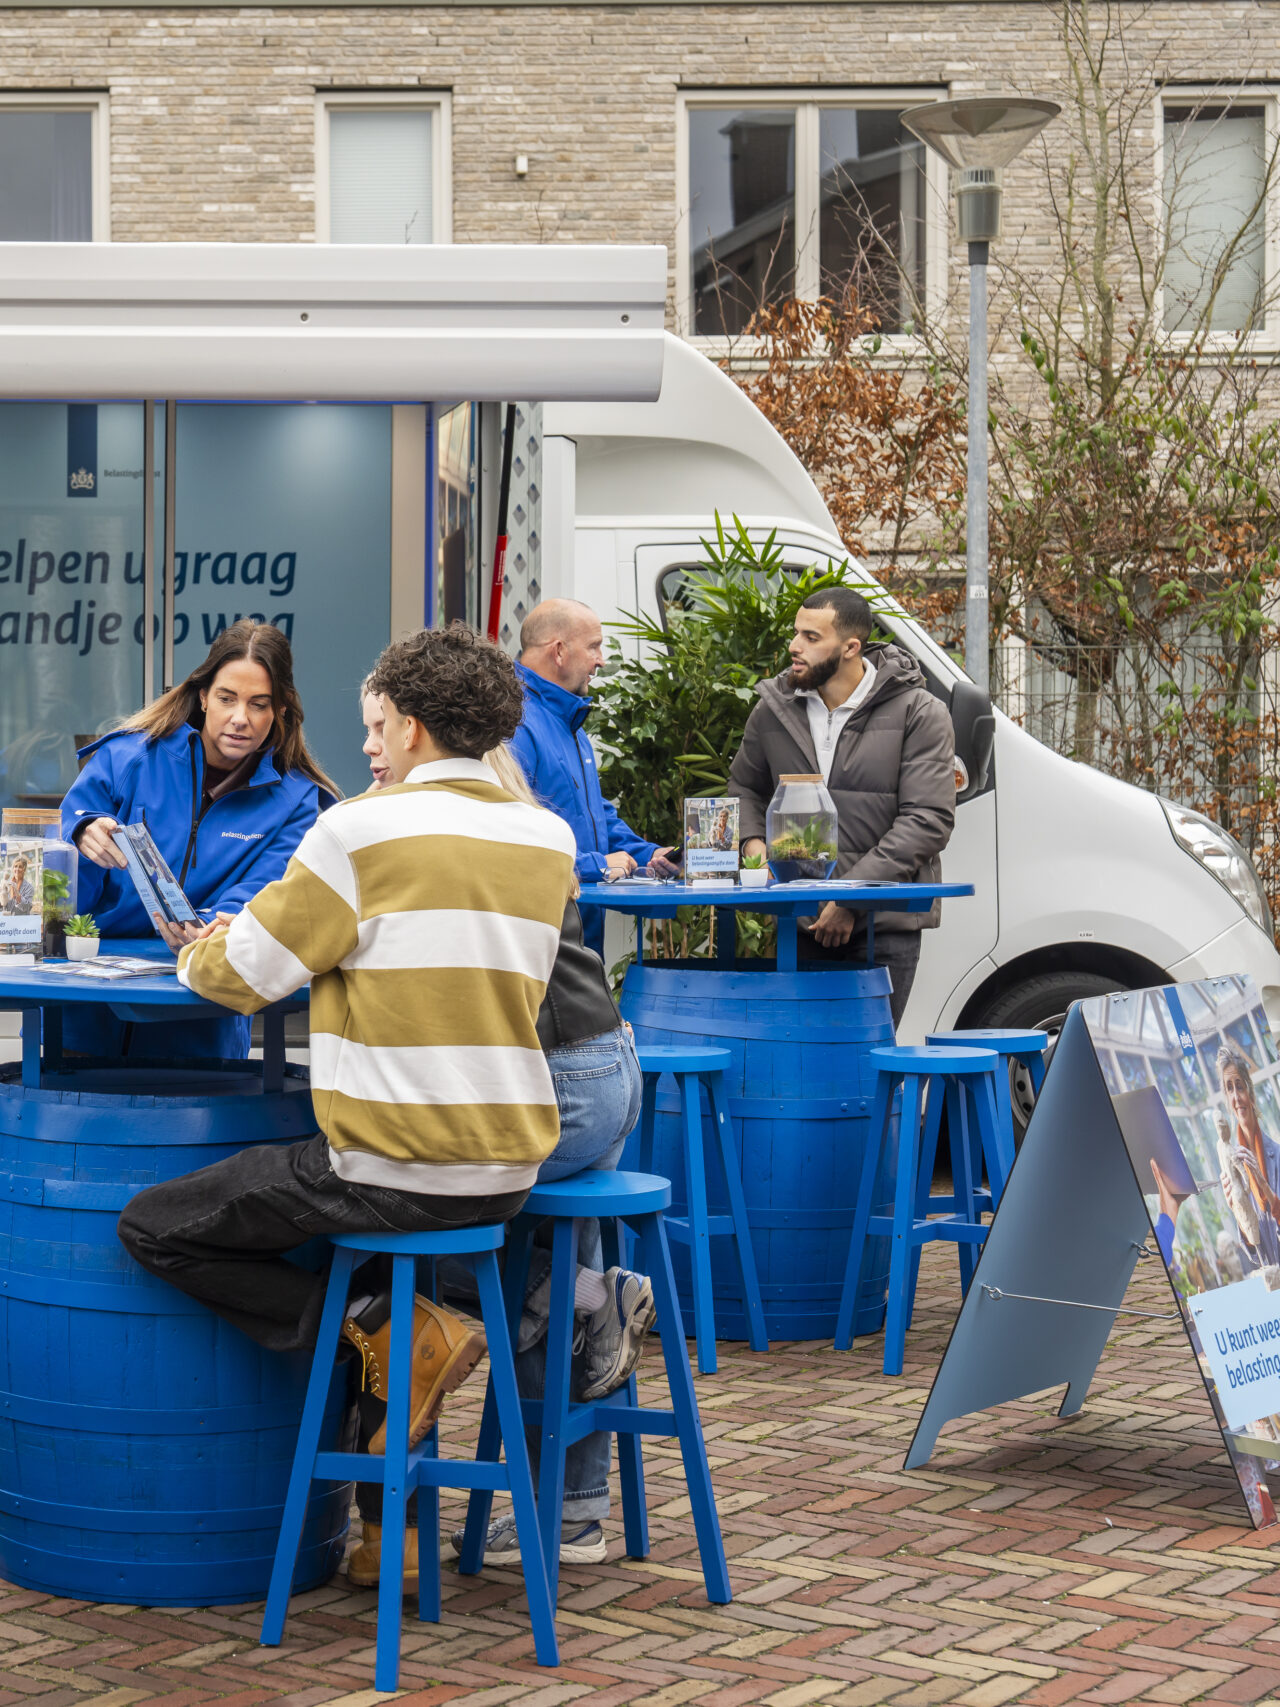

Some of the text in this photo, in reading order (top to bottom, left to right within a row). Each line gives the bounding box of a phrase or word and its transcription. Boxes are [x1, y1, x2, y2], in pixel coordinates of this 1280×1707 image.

[162, 551, 297, 597] graag
[22, 927, 37, 935] doen
[1214, 1317, 1280, 1356] U kunt wee
